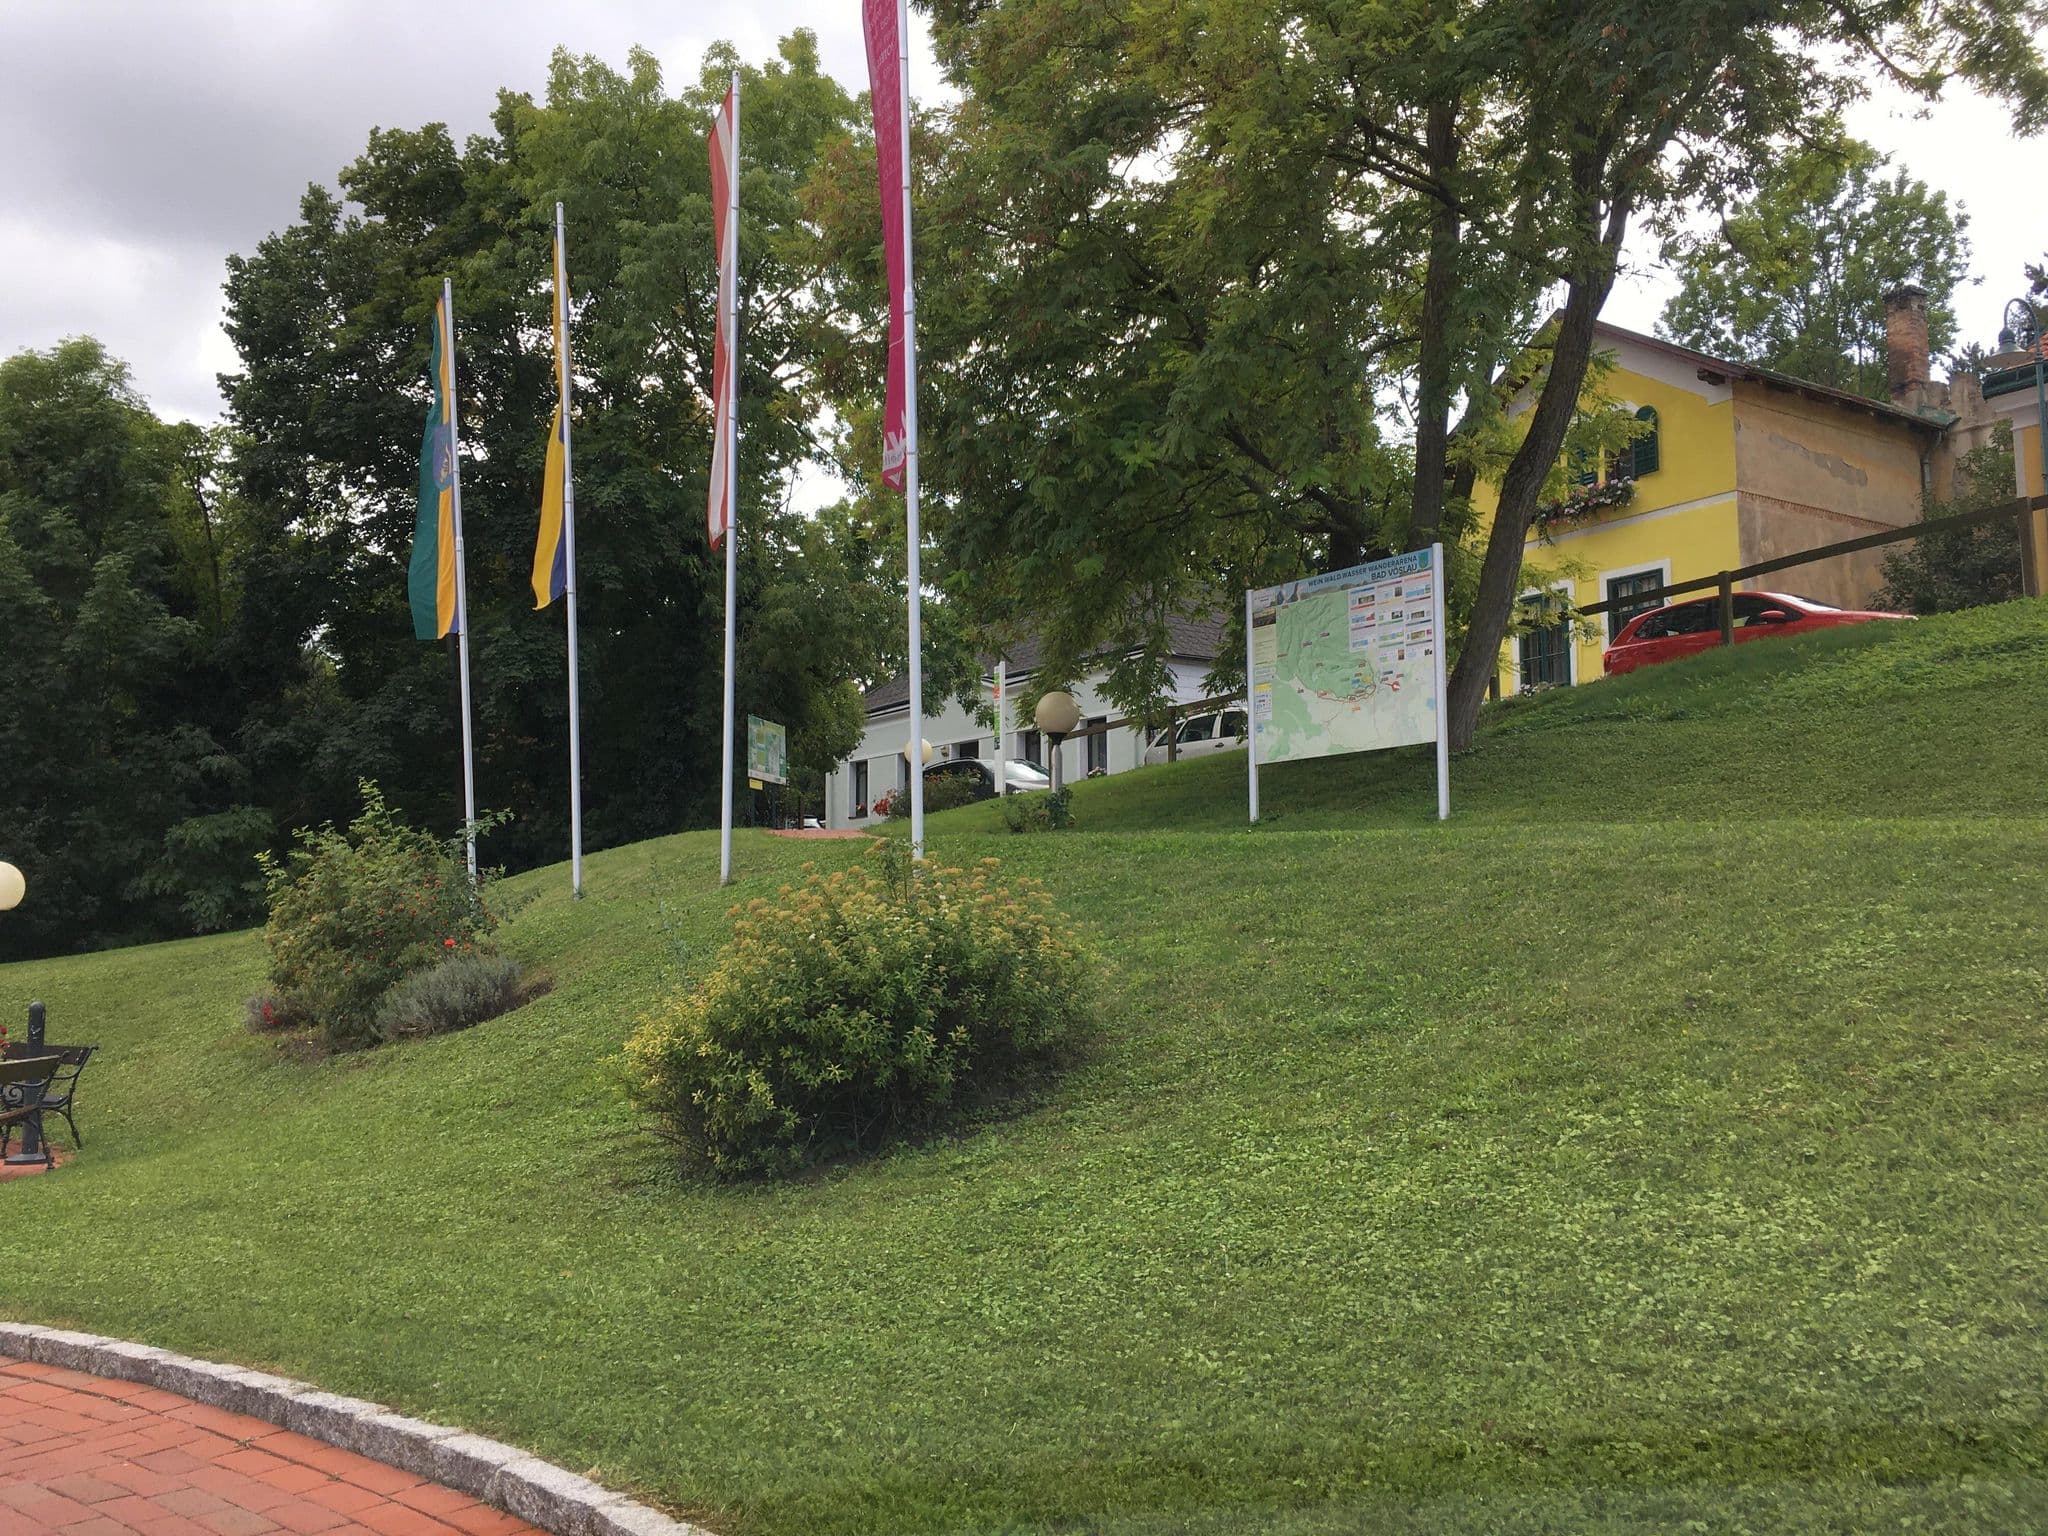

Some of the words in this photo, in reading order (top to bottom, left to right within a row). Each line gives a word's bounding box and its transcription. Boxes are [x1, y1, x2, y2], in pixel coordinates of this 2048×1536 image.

[1325, 573, 1342, 583] WALD
[1342, 567, 1367, 578] WASSER
[1371, 570, 1387, 581] BAD
